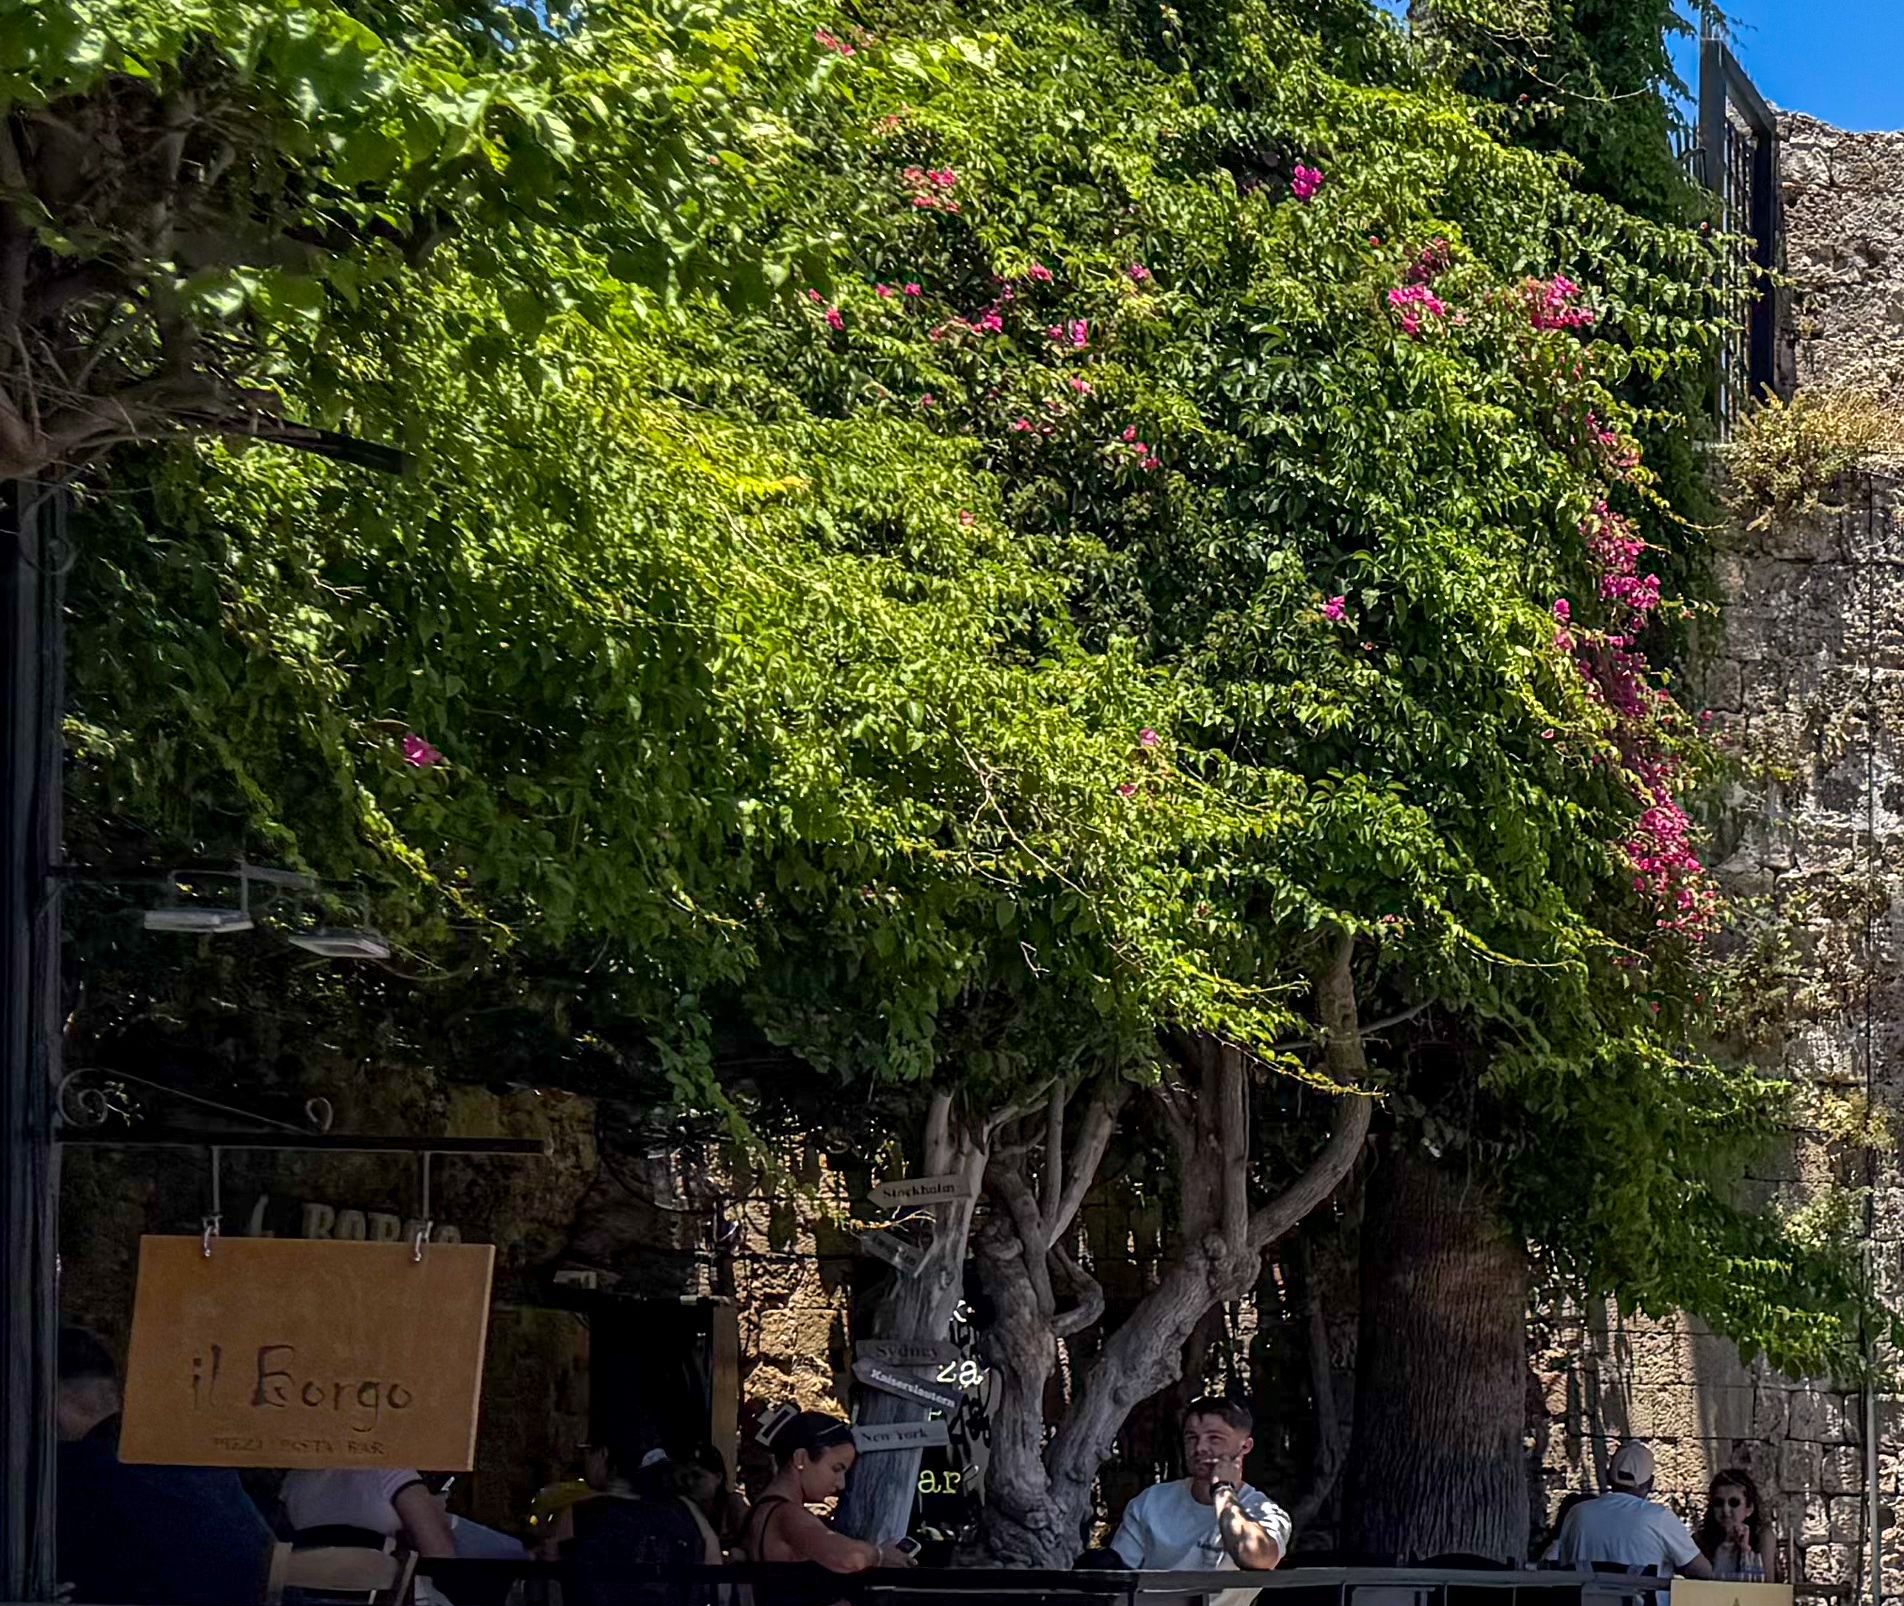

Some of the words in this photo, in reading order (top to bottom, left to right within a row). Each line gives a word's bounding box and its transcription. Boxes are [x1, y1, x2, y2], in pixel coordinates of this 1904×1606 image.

[882, 1183, 956, 1200] Stockholm
[875, 1344, 939, 1361] Sydney
[869, 1368, 956, 1409] Kaiserslautern
[861, 1432, 890, 1444] New
[896, 1427, 929, 1441] York
